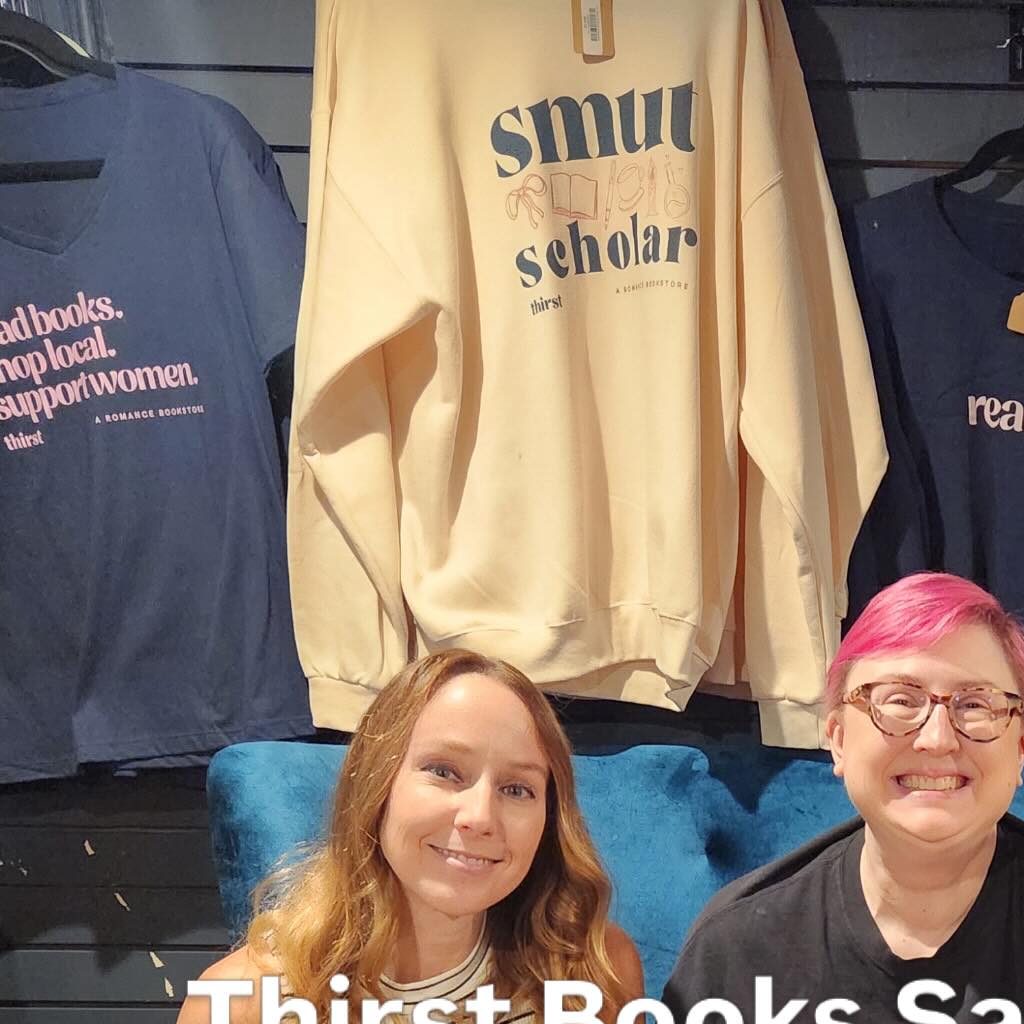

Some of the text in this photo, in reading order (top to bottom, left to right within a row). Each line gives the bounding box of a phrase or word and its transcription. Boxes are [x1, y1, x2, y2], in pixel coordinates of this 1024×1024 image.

[490, 80, 696, 178] smut
[515, 212, 698, 288] scholar
[530, 293, 563, 316] thirst
[0, 371, 90, 424] support
[95, 416, 101, 424] A
[105, 409, 155, 423] ROMANCE
[3, 430, 45, 451] thirst
